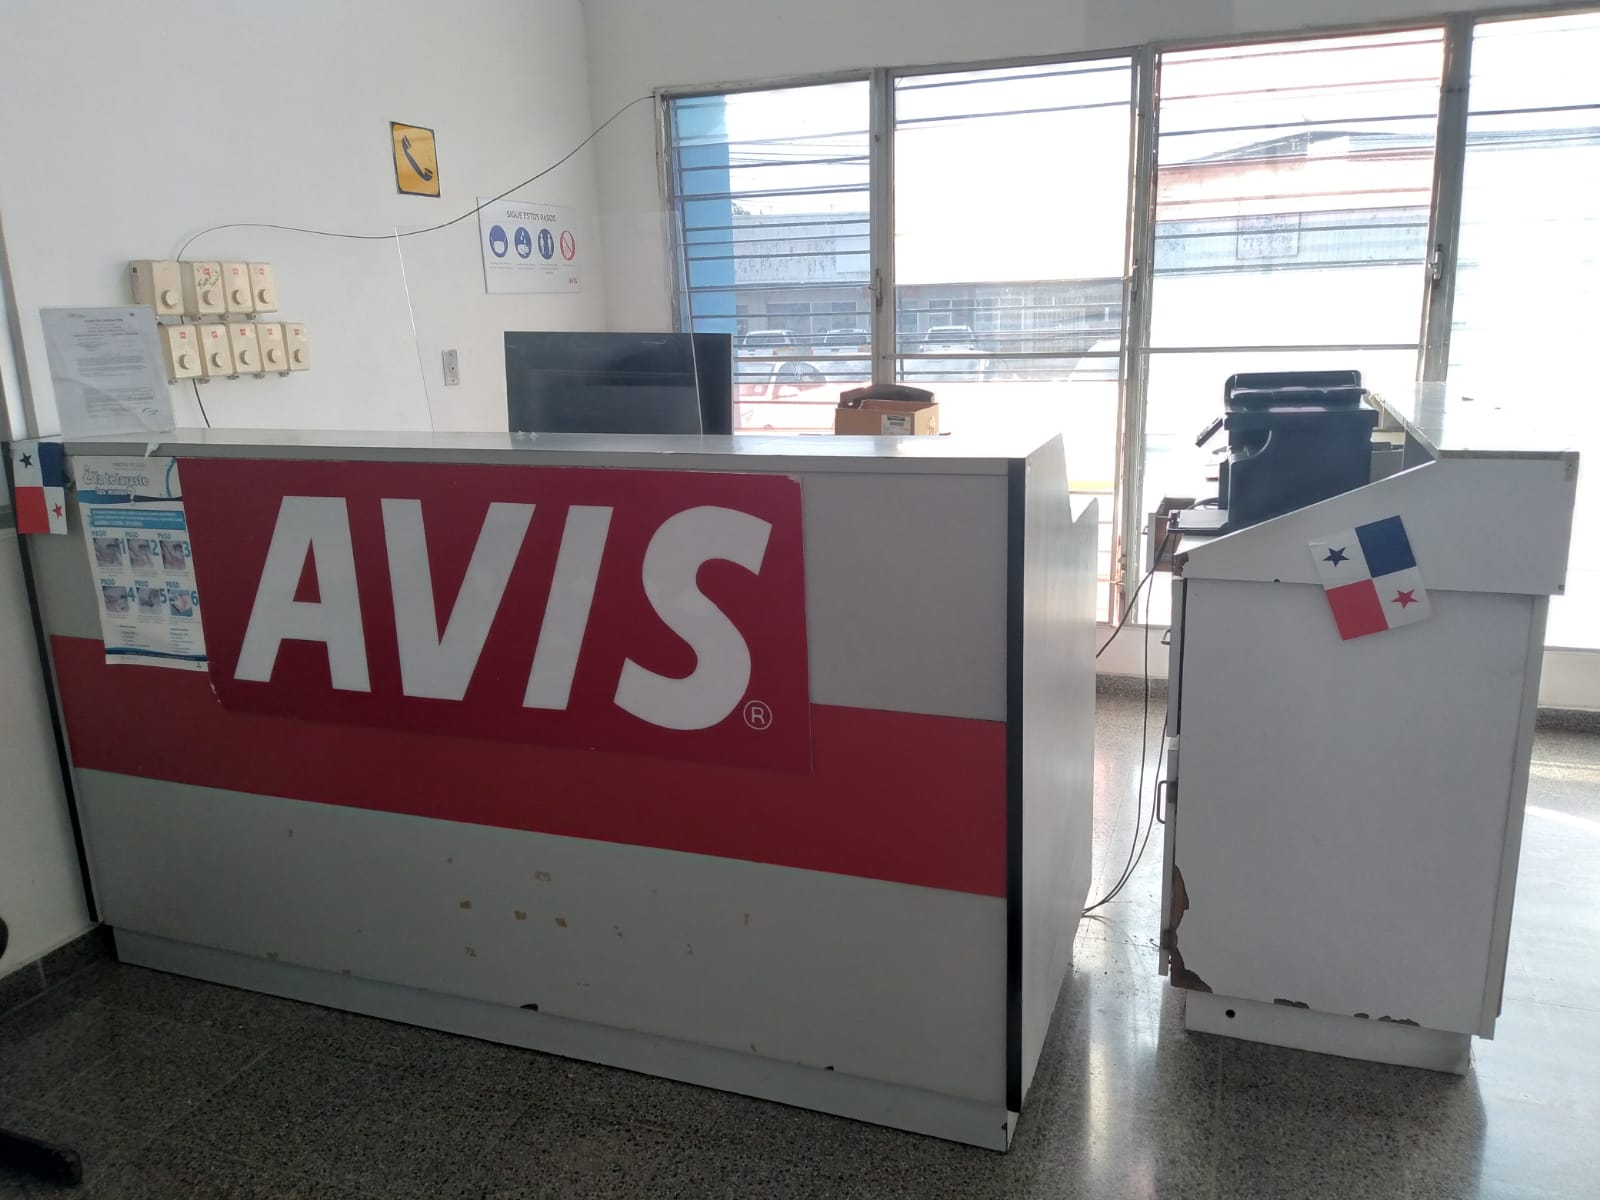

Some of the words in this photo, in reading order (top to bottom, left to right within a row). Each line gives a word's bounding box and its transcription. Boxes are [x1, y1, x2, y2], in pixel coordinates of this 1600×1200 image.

[506, 210, 523, 219] SIGUE
[523, 211, 540, 221] ESTOS
[540, 213, 556, 223] PASOS
[120, 538, 127, 555] 1
[150, 540, 159, 556] 2
[182, 541, 191, 558] 3
[101, 578, 116, 586] PASO
[127, 586, 136, 602] 4
[134, 580, 149, 588] PASO
[159, 588, 167, 604] 5
[165, 581, 180, 589] PASO
[190, 590, 199, 606] 6
[233, 494, 774, 731] AVIS
